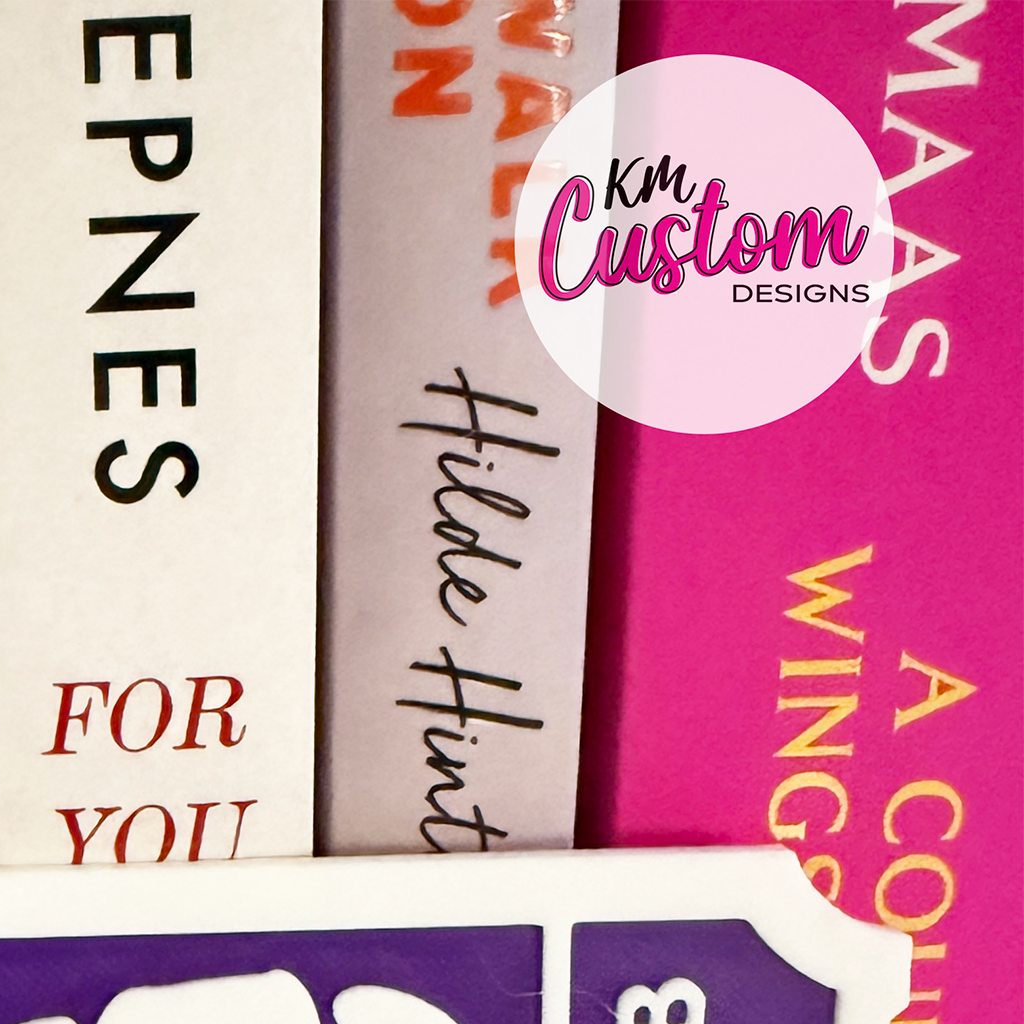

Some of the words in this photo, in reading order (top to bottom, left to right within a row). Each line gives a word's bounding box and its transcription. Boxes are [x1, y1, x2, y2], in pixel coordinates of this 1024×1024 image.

[82, 14, 201, 505] EPNES
[860, 0, 988, 386] MAAS
[399, 366, 562, 628] Hilde
[41, 675, 247, 756] FOR
[893, 650, 978, 732] A
[55, 799, 259, 865] YOU
